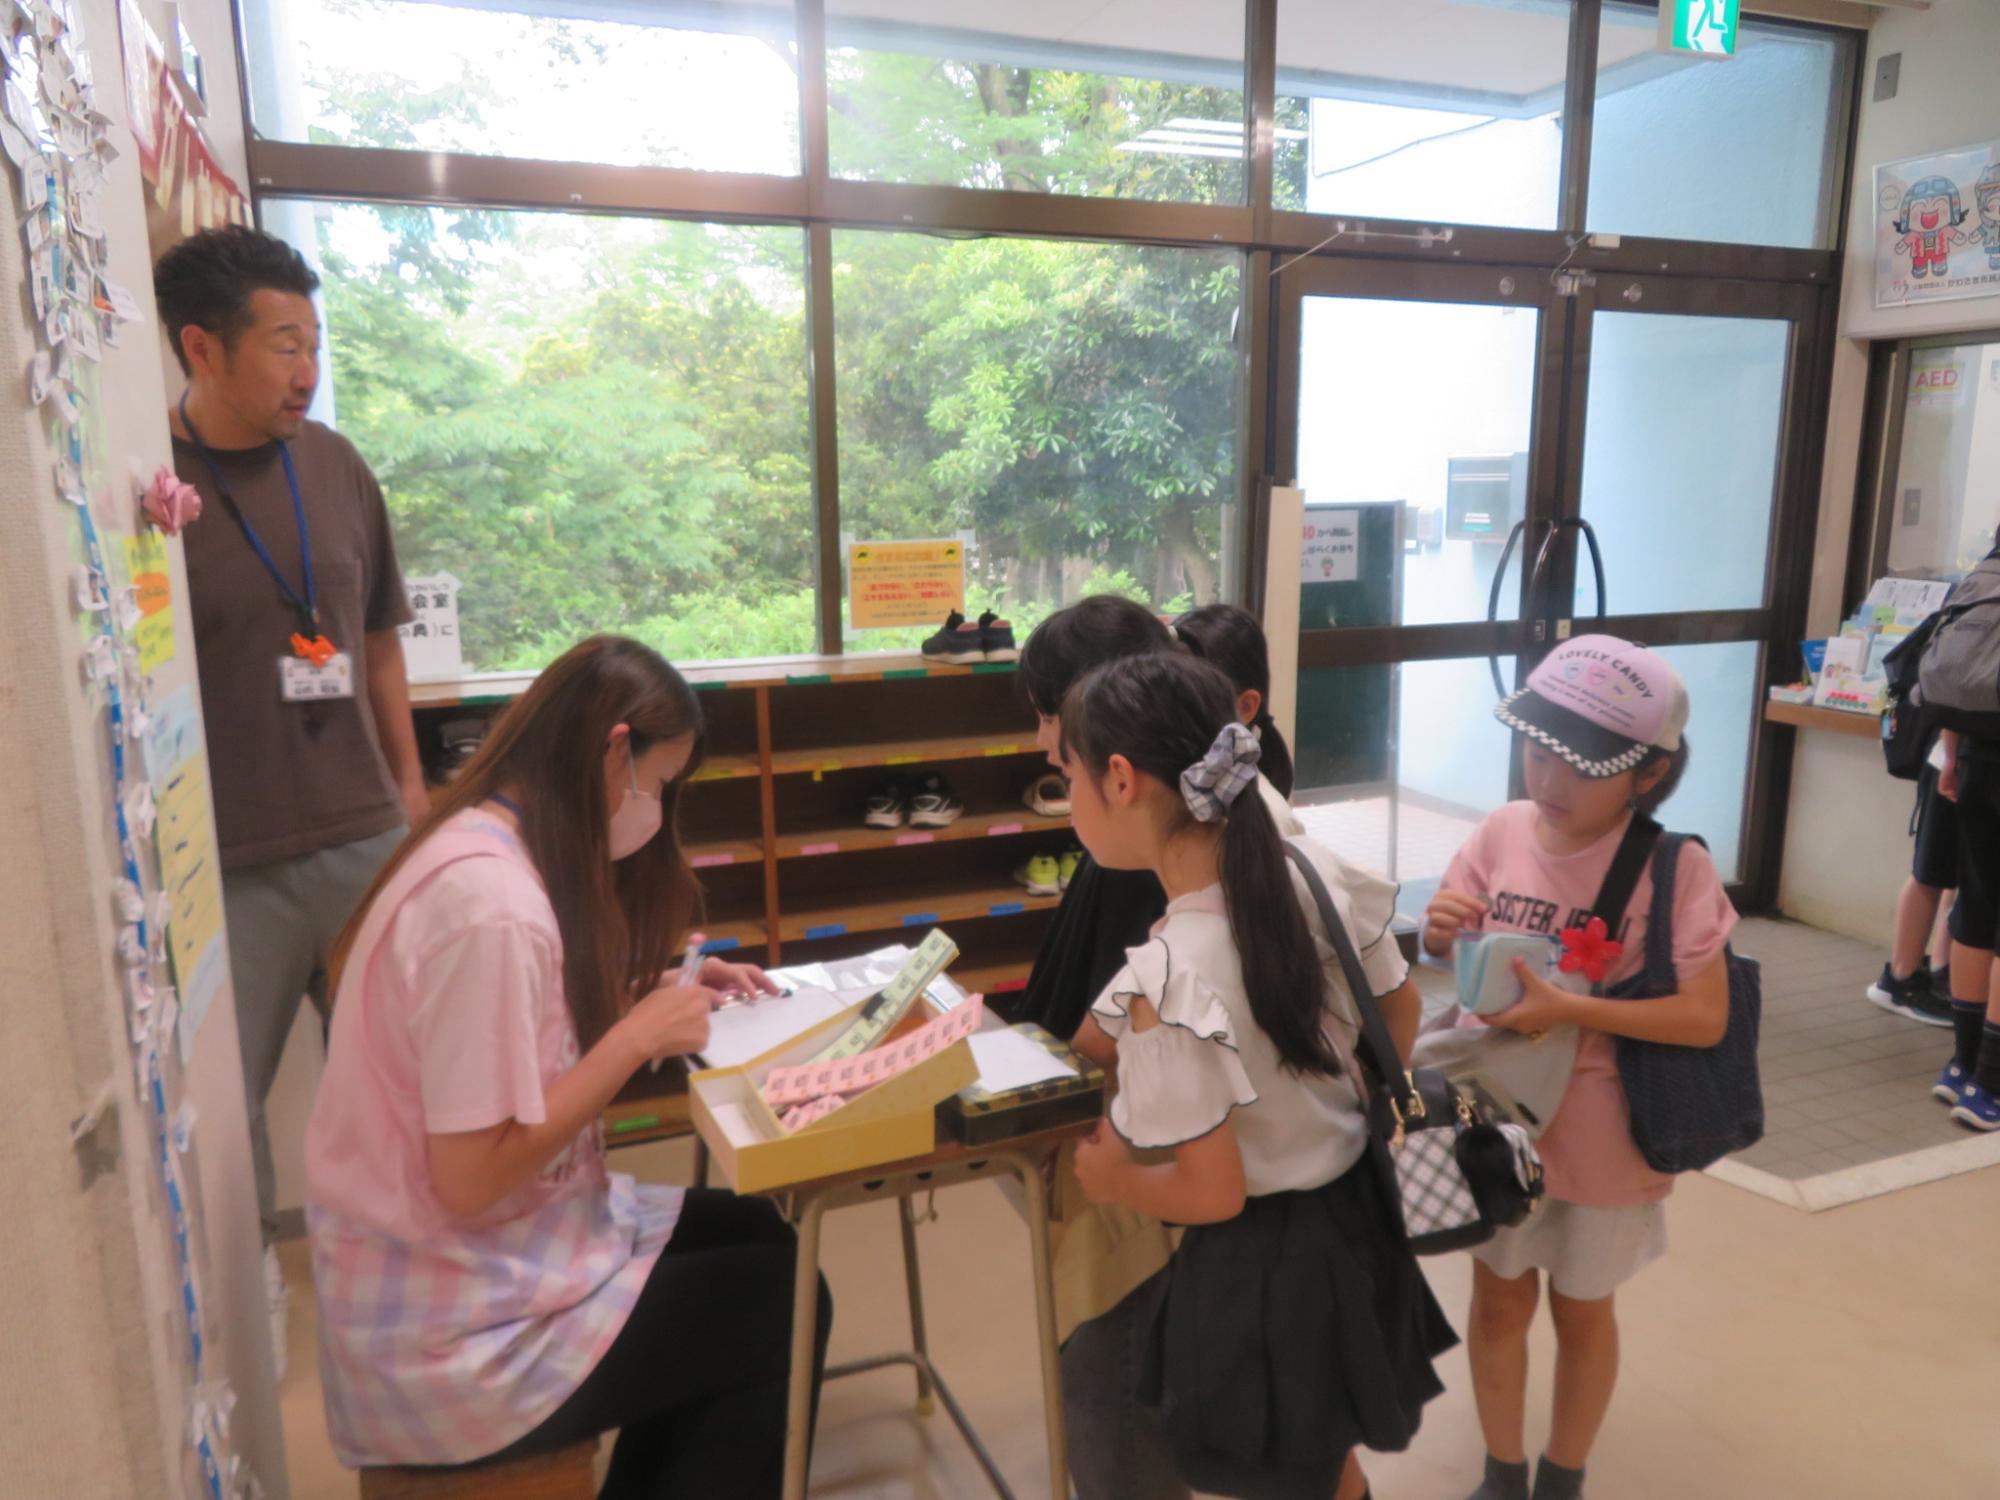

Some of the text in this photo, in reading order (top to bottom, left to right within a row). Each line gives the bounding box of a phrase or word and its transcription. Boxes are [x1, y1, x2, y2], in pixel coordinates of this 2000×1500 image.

[1915, 368, 1958, 388] AED
[1559, 649, 1610, 661] LOVELY
[1611, 659, 1655, 698] CANDY
[1491, 891, 1559, 934] SISTER
